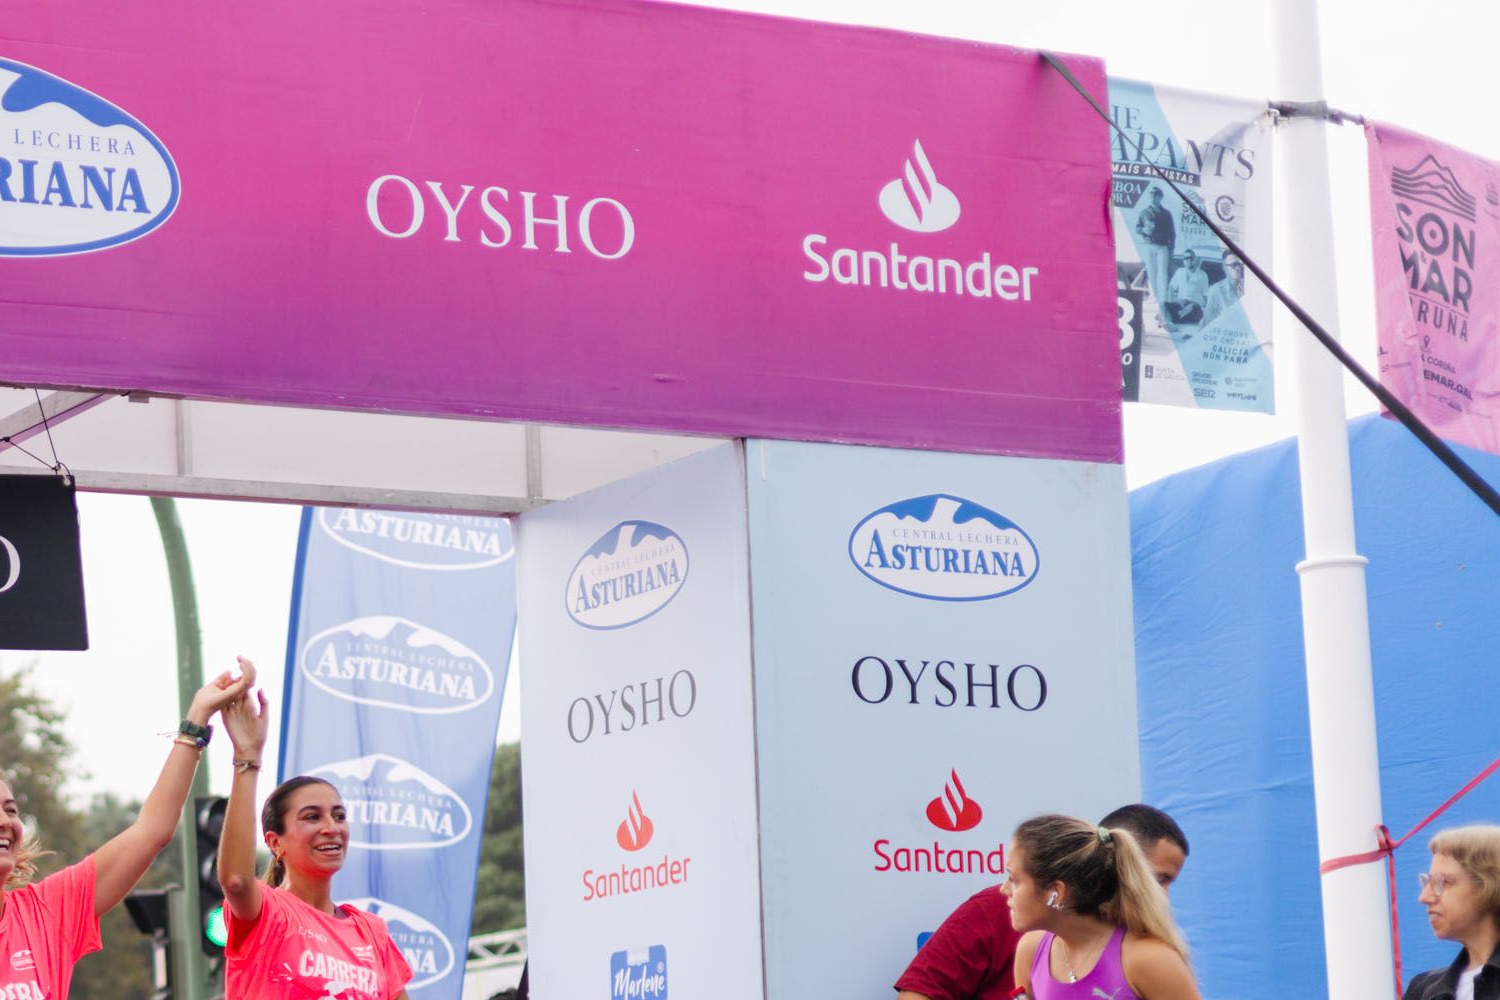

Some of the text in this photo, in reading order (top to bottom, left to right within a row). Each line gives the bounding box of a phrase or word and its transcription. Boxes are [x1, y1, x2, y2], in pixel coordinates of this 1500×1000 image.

[12, 128, 138, 157] LECHERA
[366, 173, 636, 259] OYSHO
[1395, 202, 1475, 270] SON
[802, 234, 1039, 301] Santander
[1202, 351, 1249, 365] NON PARA
[1212, 345, 1249, 357] GALICIA
[864, 528, 1027, 578] ASTURIANA
[892, 528, 1020, 546] CENTRAL LECHERA
[574, 558, 681, 614] ASTURIANA
[314, 642, 476, 700] ASTURIANA
[851, 656, 1048, 712] OYSHO
[567, 669, 696, 743] OYSHO
[343, 798, 454, 837] TURIANA
[583, 855, 691, 901] Santander
[874, 839, 1005, 874] Santand
